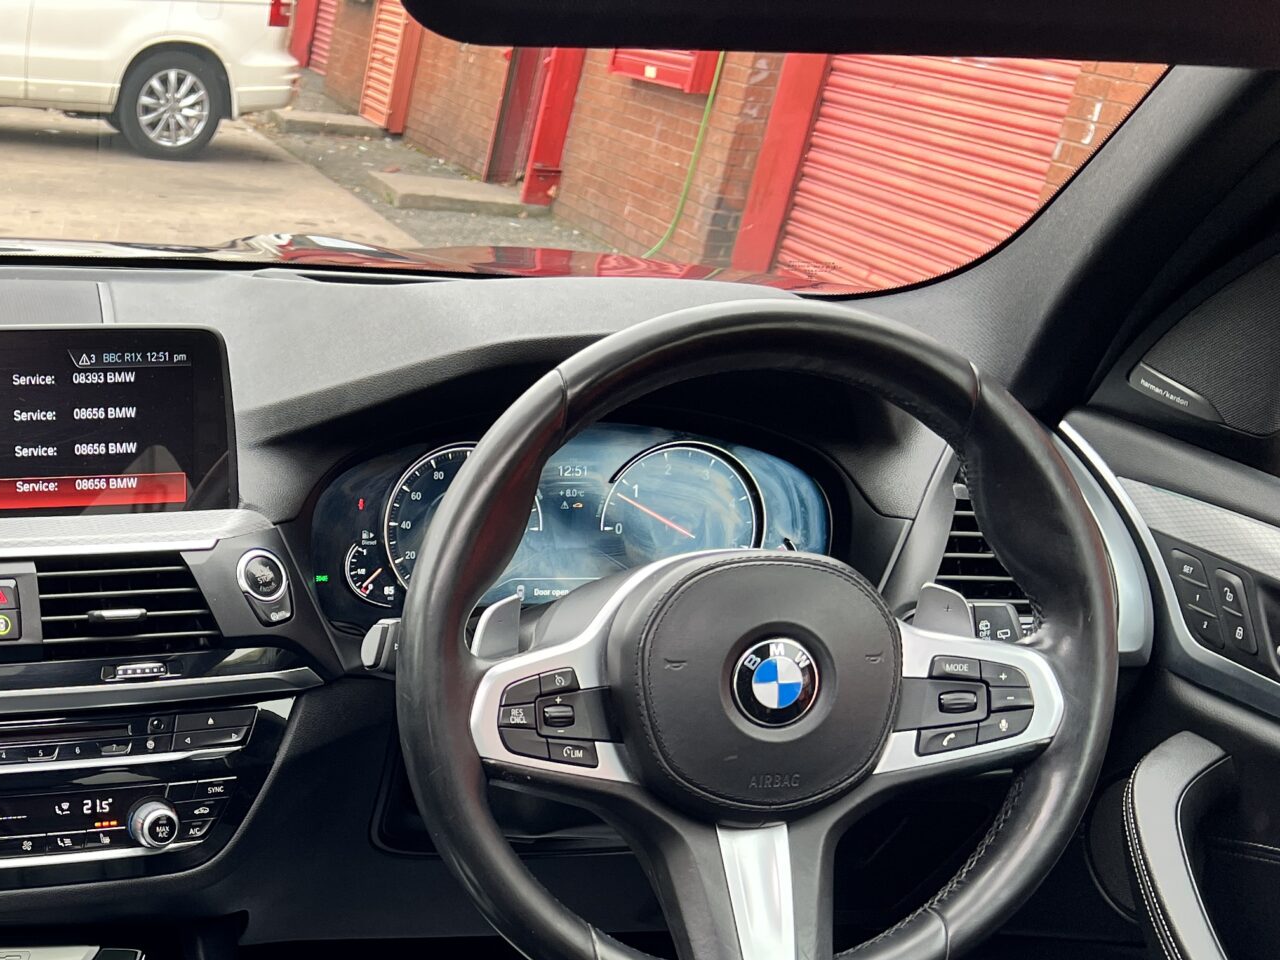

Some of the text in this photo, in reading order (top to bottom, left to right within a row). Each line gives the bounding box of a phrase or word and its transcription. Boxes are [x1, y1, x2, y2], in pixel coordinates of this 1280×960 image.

[90, 352, 187, 364] 3 BBC R1X 12:51 pm
[12, 374, 55, 386] Service:
[72, 372, 105, 383] 08393
[106, 371, 136, 383] BMW
[1140, 377, 1190, 407] harman/kardon
[13, 409, 56, 421] Service:
[73, 408, 105, 420] 08656
[107, 407, 137, 419] BMW
[14, 445, 58, 457] Service:
[74, 443, 106, 455] 08656
[108, 442, 137, 454] BMW
[558, 465, 588, 477] 12:51
[664, 464, 671, 475] 2
[433, 471, 444, 481] 80
[15, 480, 58, 492] Service:
[75, 479, 107, 490] 08656
[109, 477, 138, 489] BMW
[411, 491, 422, 501] 60
[632, 484, 639, 498] 1
[400, 521, 412, 530] 40
[615, 523, 623, 535] 0
[405, 551, 416, 560] 20
[1182, 564, 1194, 575] SET
[533, 587, 569, 598] Door open
[745, 642, 811, 672] BMW
[944, 663, 969, 672] MODE
[510, 708, 524, 718] RES
[509, 716, 527, 724] CNCL
[570, 749, 583, 758] LIM
[748, 773, 801, 789] AIRBAG
[207, 786, 225, 794] SYNC
[156, 825, 170, 833] MAX
[188, 827, 201, 836] A/C
[158, 831, 169, 839] A/C
